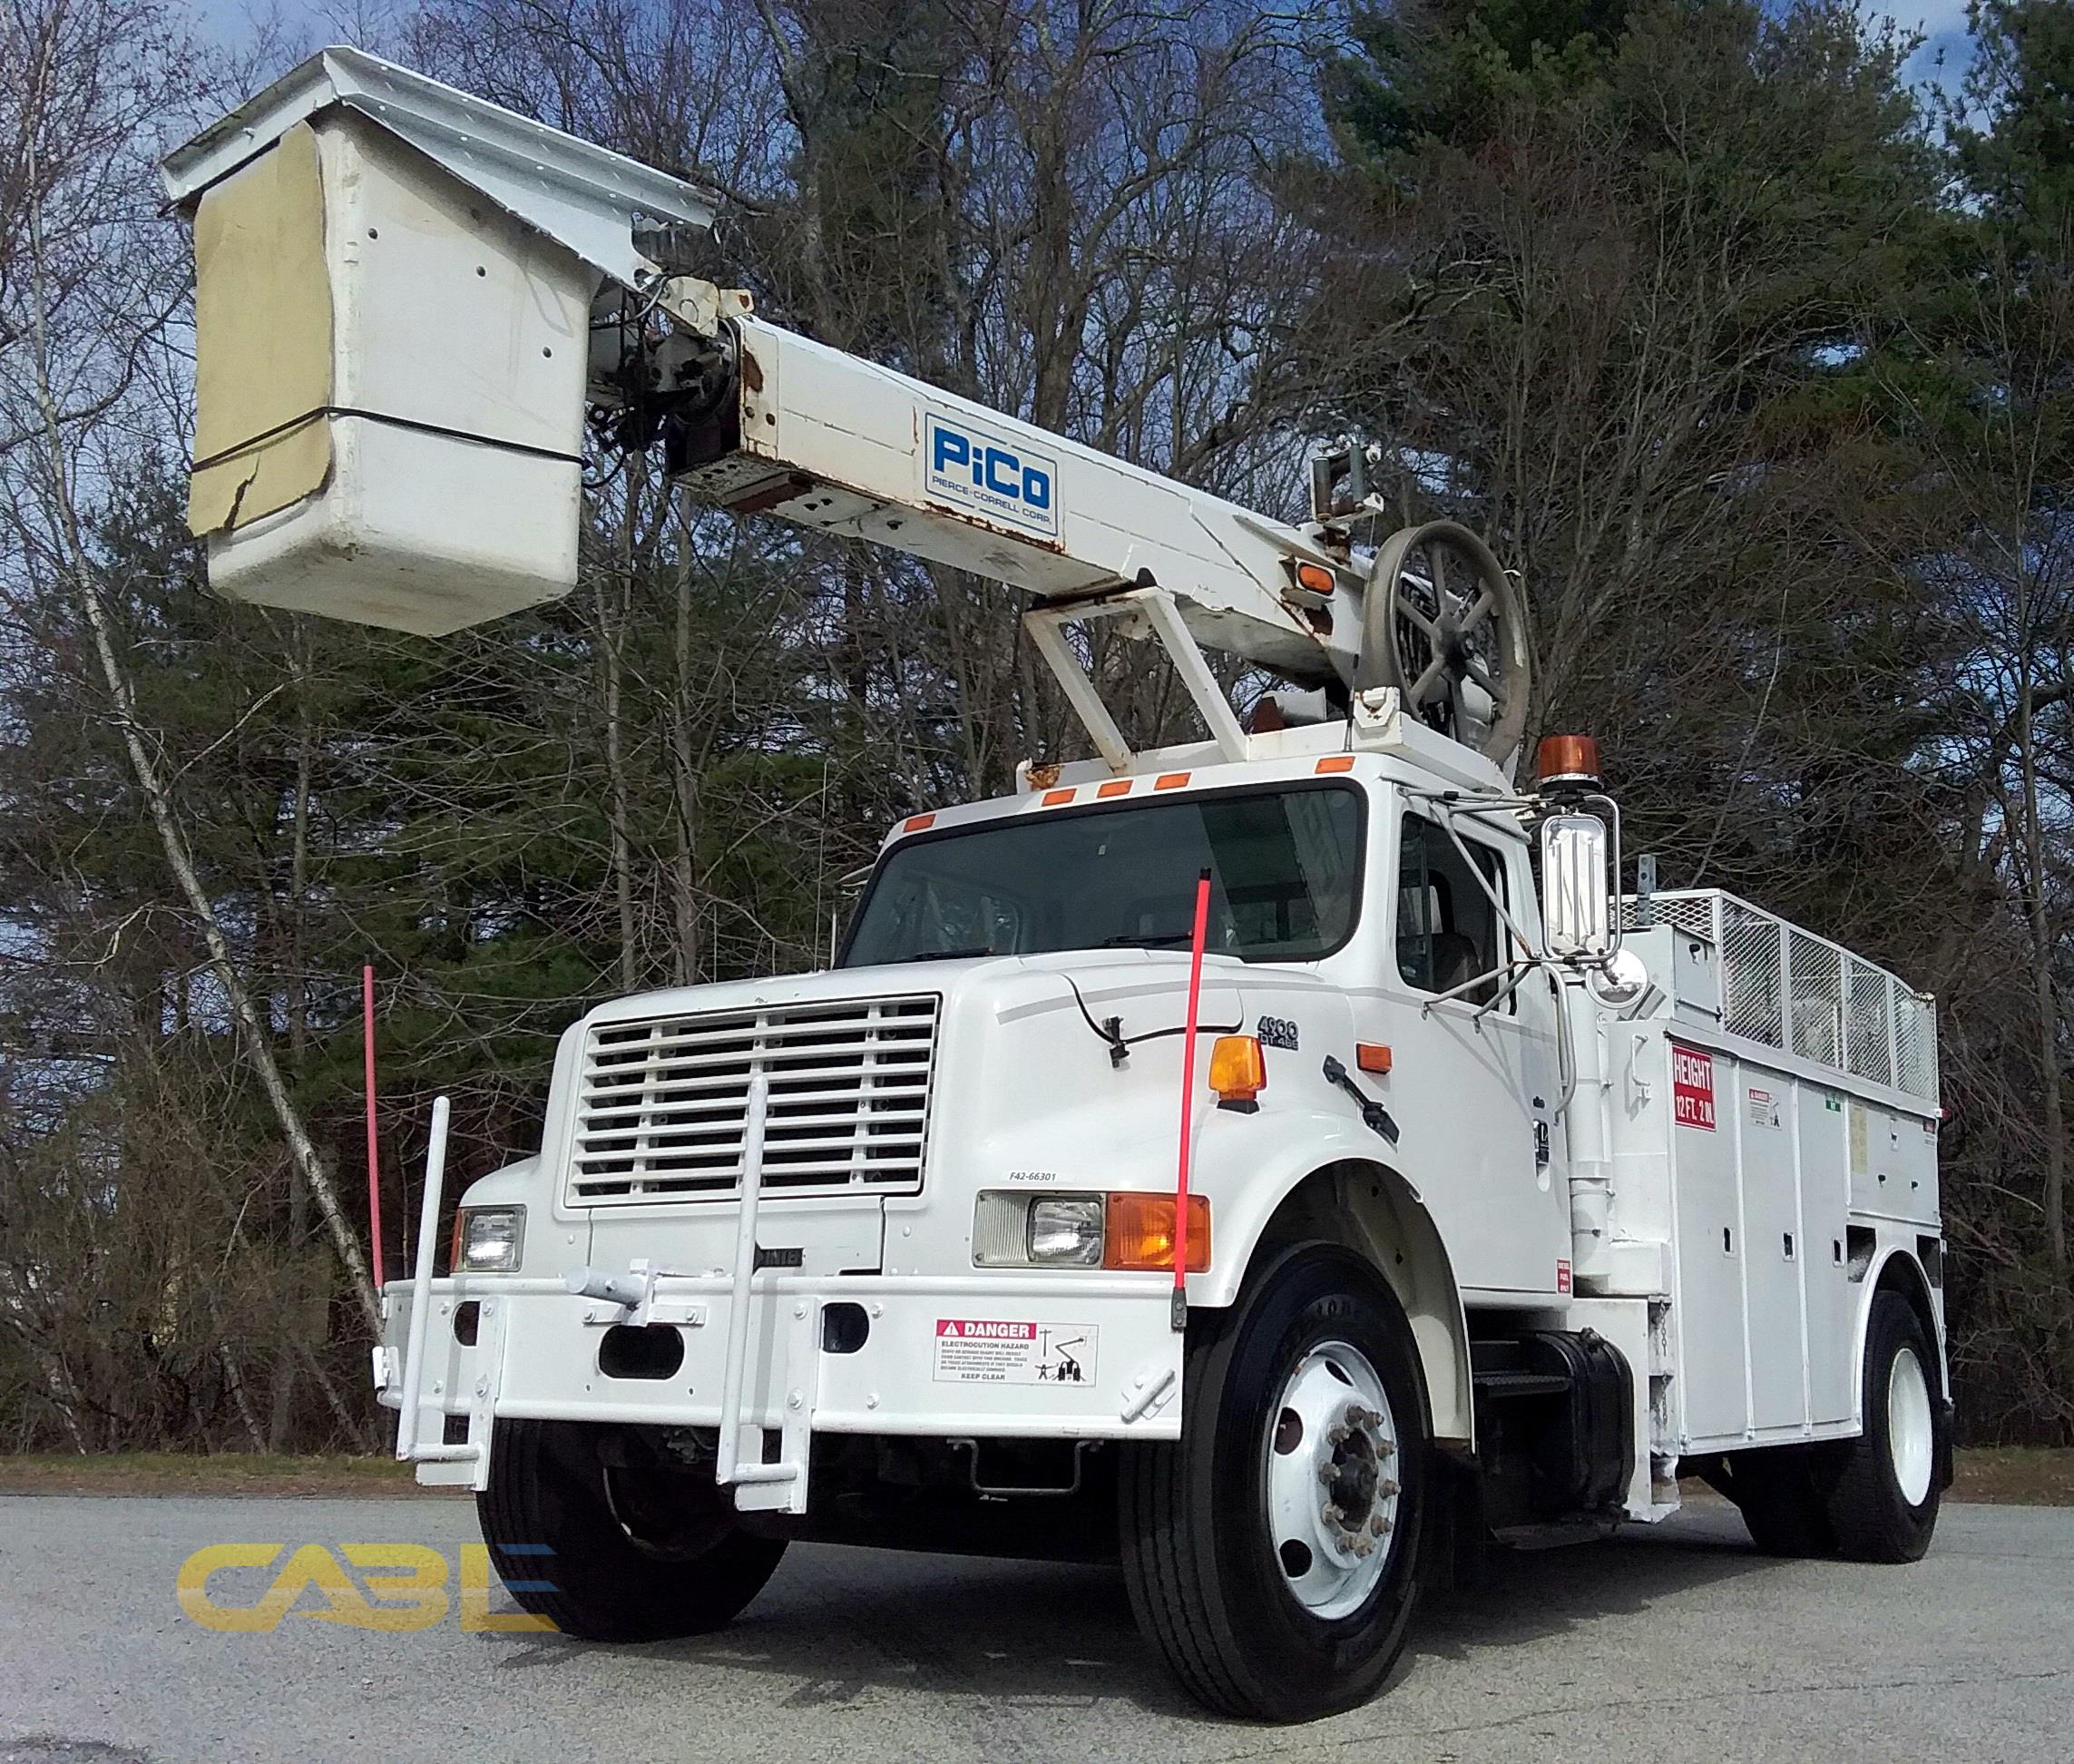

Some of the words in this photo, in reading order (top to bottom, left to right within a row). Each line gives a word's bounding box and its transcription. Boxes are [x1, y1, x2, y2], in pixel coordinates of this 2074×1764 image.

[1257, 1015, 1299, 1040] 4900
[1673, 1052, 1711, 1091] HEIGHT
[1676, 1095, 1686, 1118] 12
[1699, 1100, 1705, 1122] 2
[964, 1322, 1030, 1338] DANGER
[941, 1340, 1000, 1349] ELECTROCUTION
[1001, 1342, 1030, 1350] HAZARD
